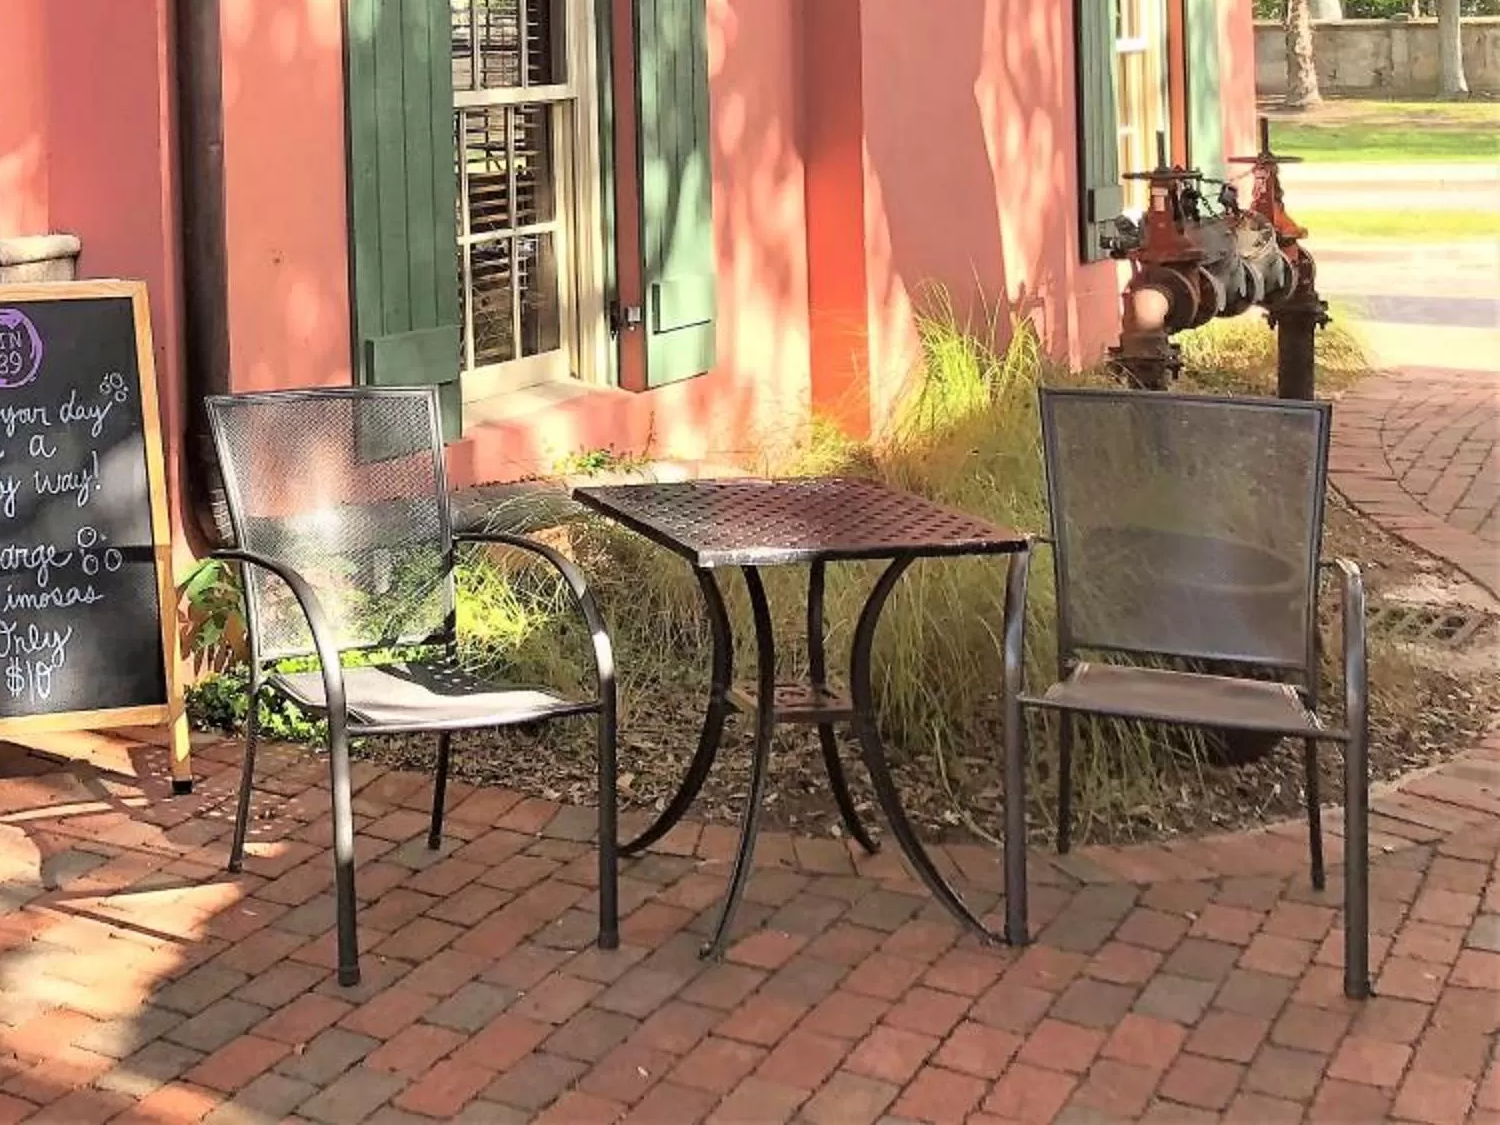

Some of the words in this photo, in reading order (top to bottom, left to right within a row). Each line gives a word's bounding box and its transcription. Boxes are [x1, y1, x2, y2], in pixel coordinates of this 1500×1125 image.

[60, 389, 112, 437] day
[29, 435, 56, 459] a
[35, 450, 102, 507] way!
[6, 660, 52, 703] $10
